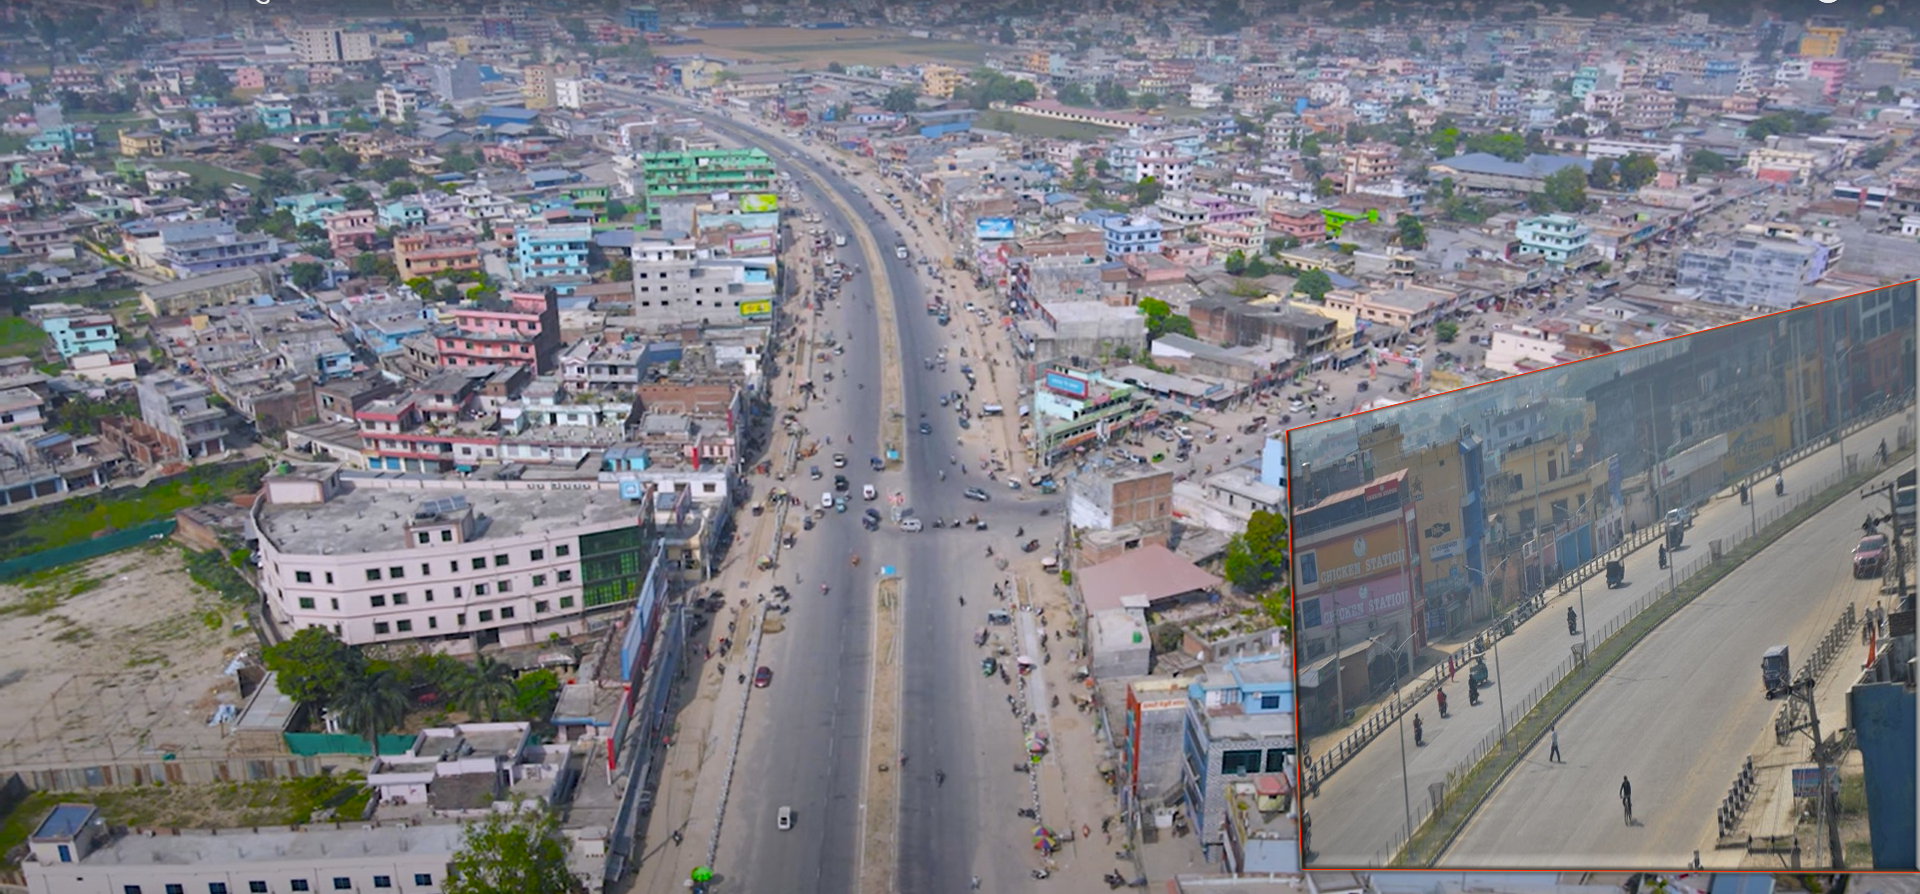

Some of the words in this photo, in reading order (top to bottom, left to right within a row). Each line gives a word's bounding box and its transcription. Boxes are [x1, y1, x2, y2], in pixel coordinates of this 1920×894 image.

[1321, 562, 1361, 584] CHICKEN
[1365, 549, 1405, 572] STATION
[1368, 590, 1409, 612] STATION
